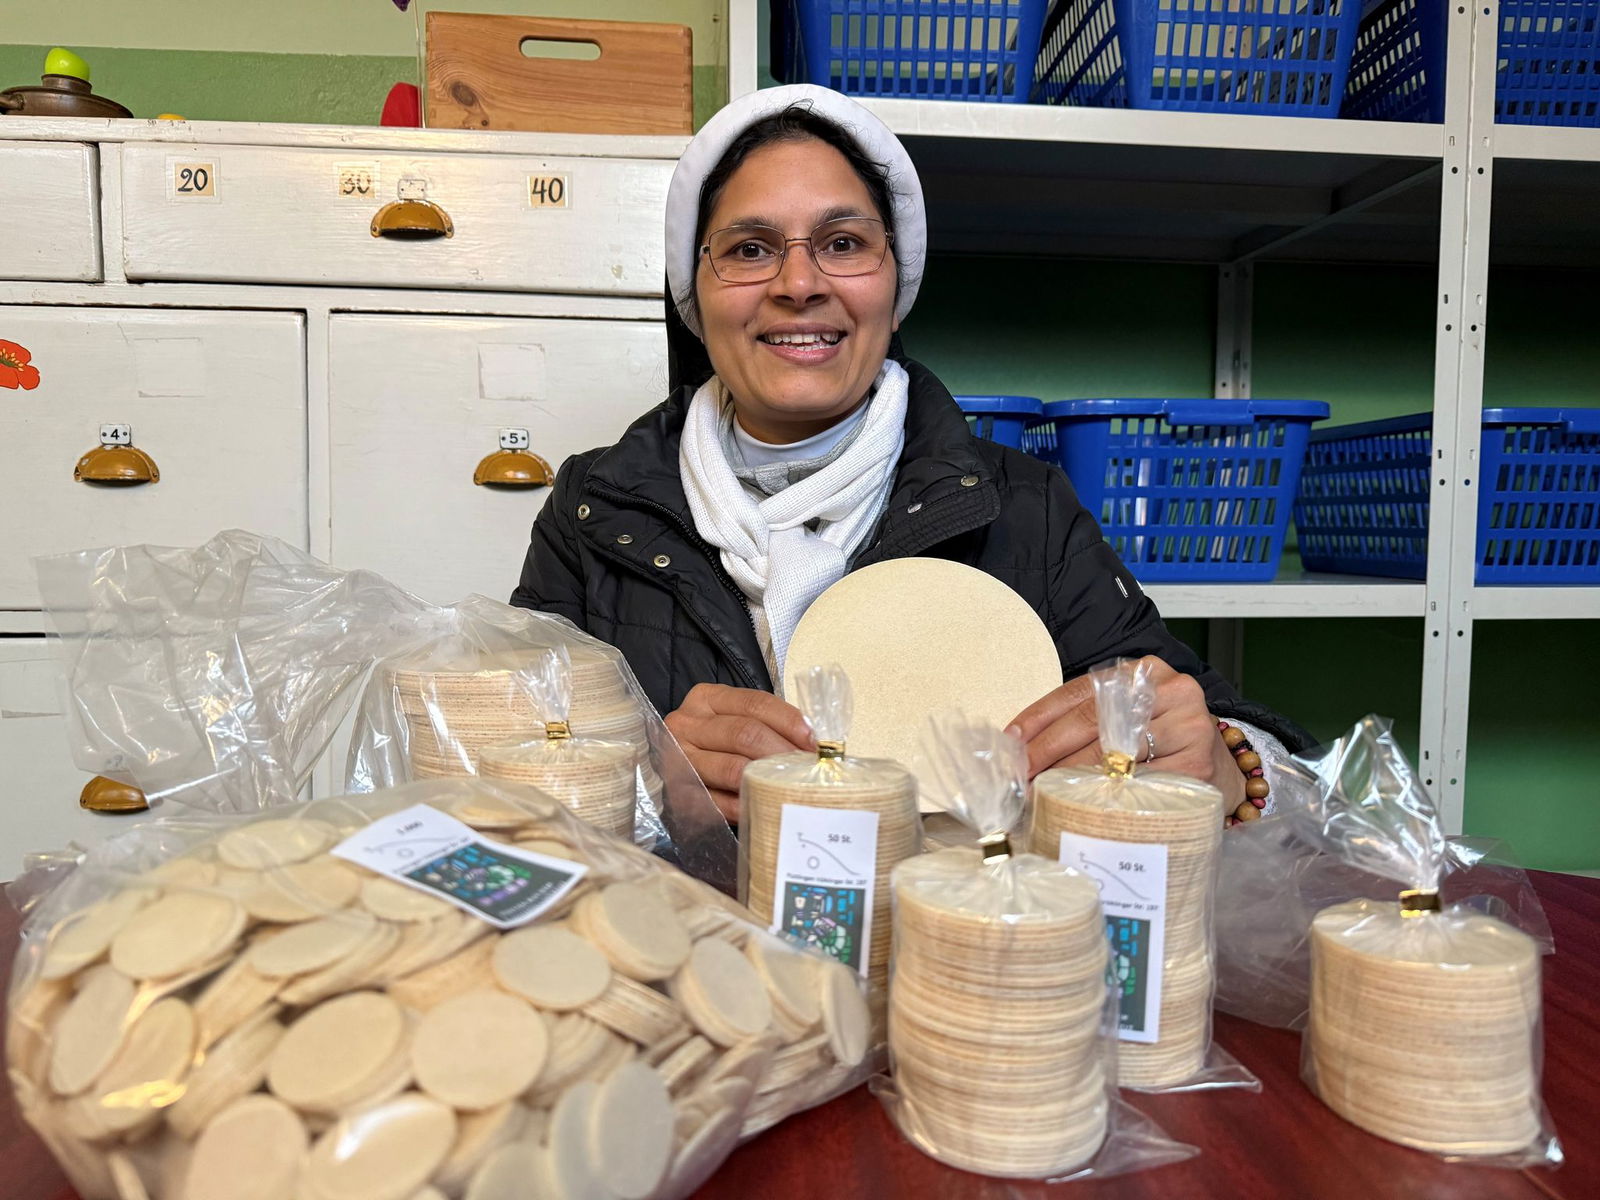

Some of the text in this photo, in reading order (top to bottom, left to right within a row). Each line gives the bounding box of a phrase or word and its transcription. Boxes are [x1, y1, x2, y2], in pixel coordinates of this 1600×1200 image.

[177, 168, 208, 192] 20
[342, 170, 371, 194] 30
[532, 177, 563, 203] 40
[110, 428, 120, 440] 4
[509, 432, 518, 444] 5
[828, 833, 839, 842] 50
[1119, 861, 1146, 872] 50 St.
